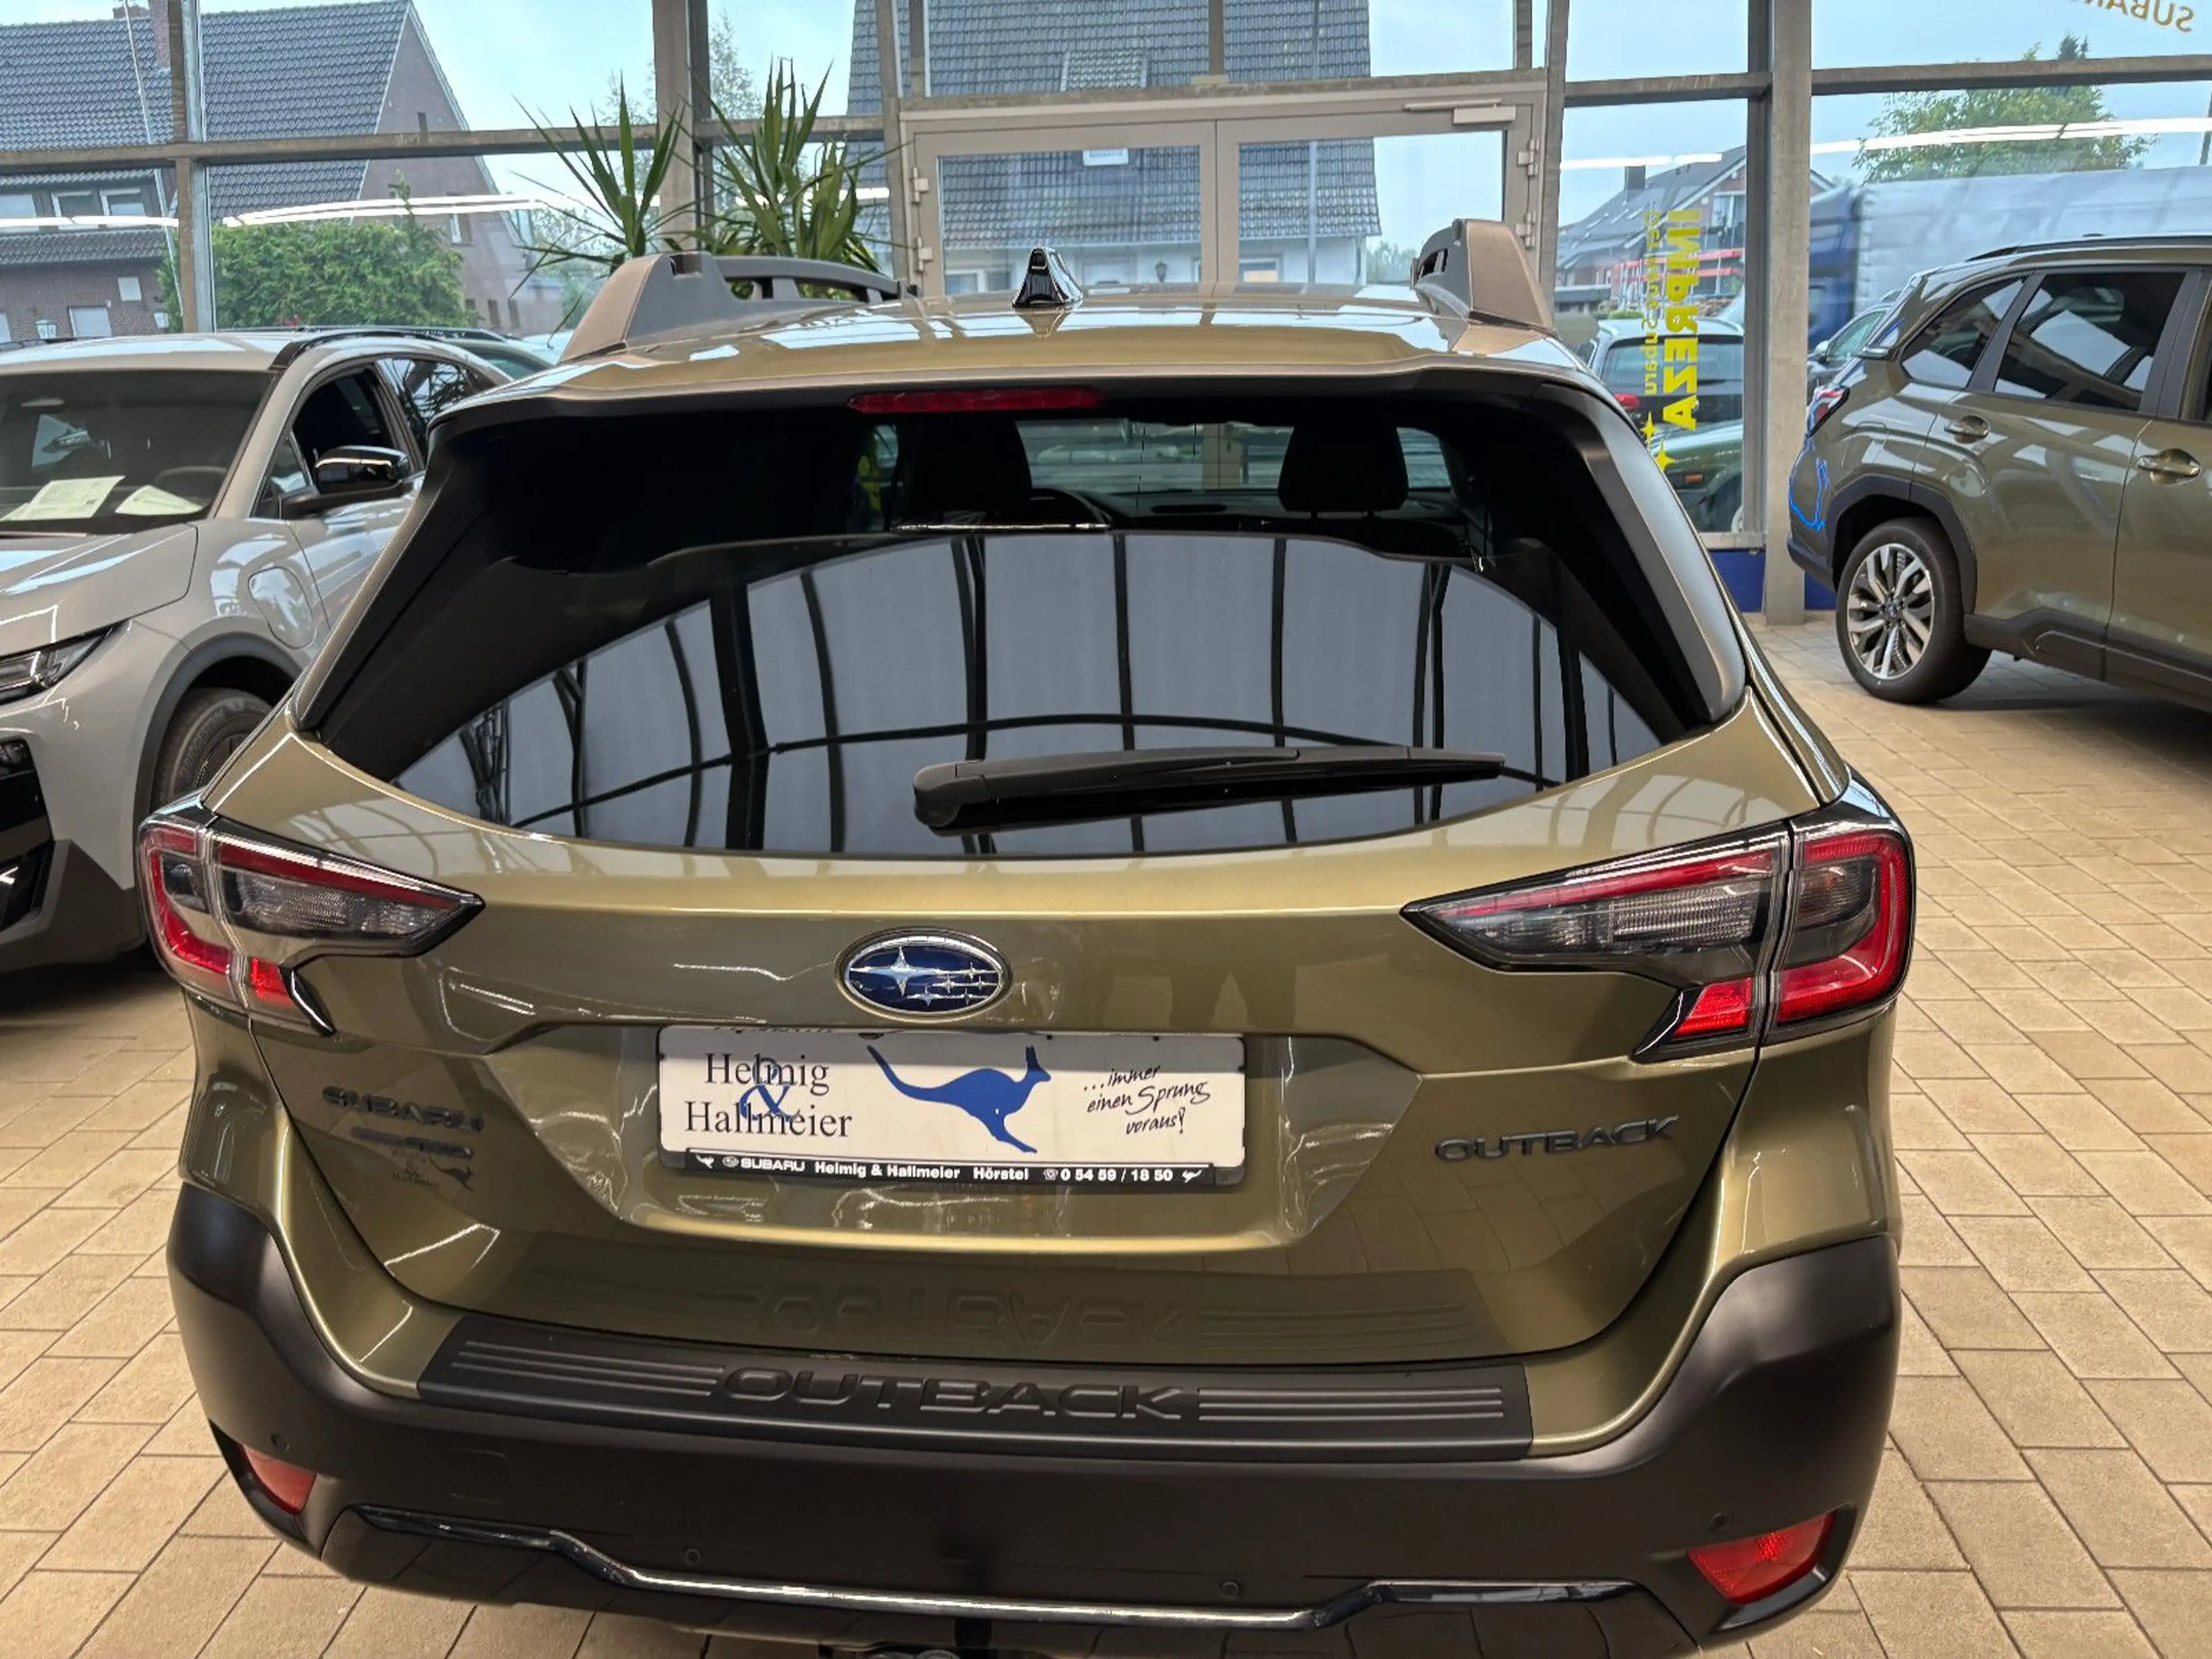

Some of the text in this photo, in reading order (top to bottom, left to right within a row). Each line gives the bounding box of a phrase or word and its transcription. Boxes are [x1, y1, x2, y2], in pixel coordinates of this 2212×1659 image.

[704, 1052, 830, 1096] Helmig
[1087, 1081, 1210, 1115] einen Sprung
[684, 1100, 853, 1137] Hallmeier
[1126, 1107, 1185, 1134] voraus!
[1435, 1114, 1679, 1161] OUTBACK
[741, 1157, 805, 1172] SUBARU
[815, 1161, 866, 1177] Helmig
[871, 1164, 883, 1176] &
[887, 1165, 960, 1179] Hallmeier
[974, 1166, 1029, 1181] Hörstel
[724, 1366, 1181, 1420] OUTBACK
